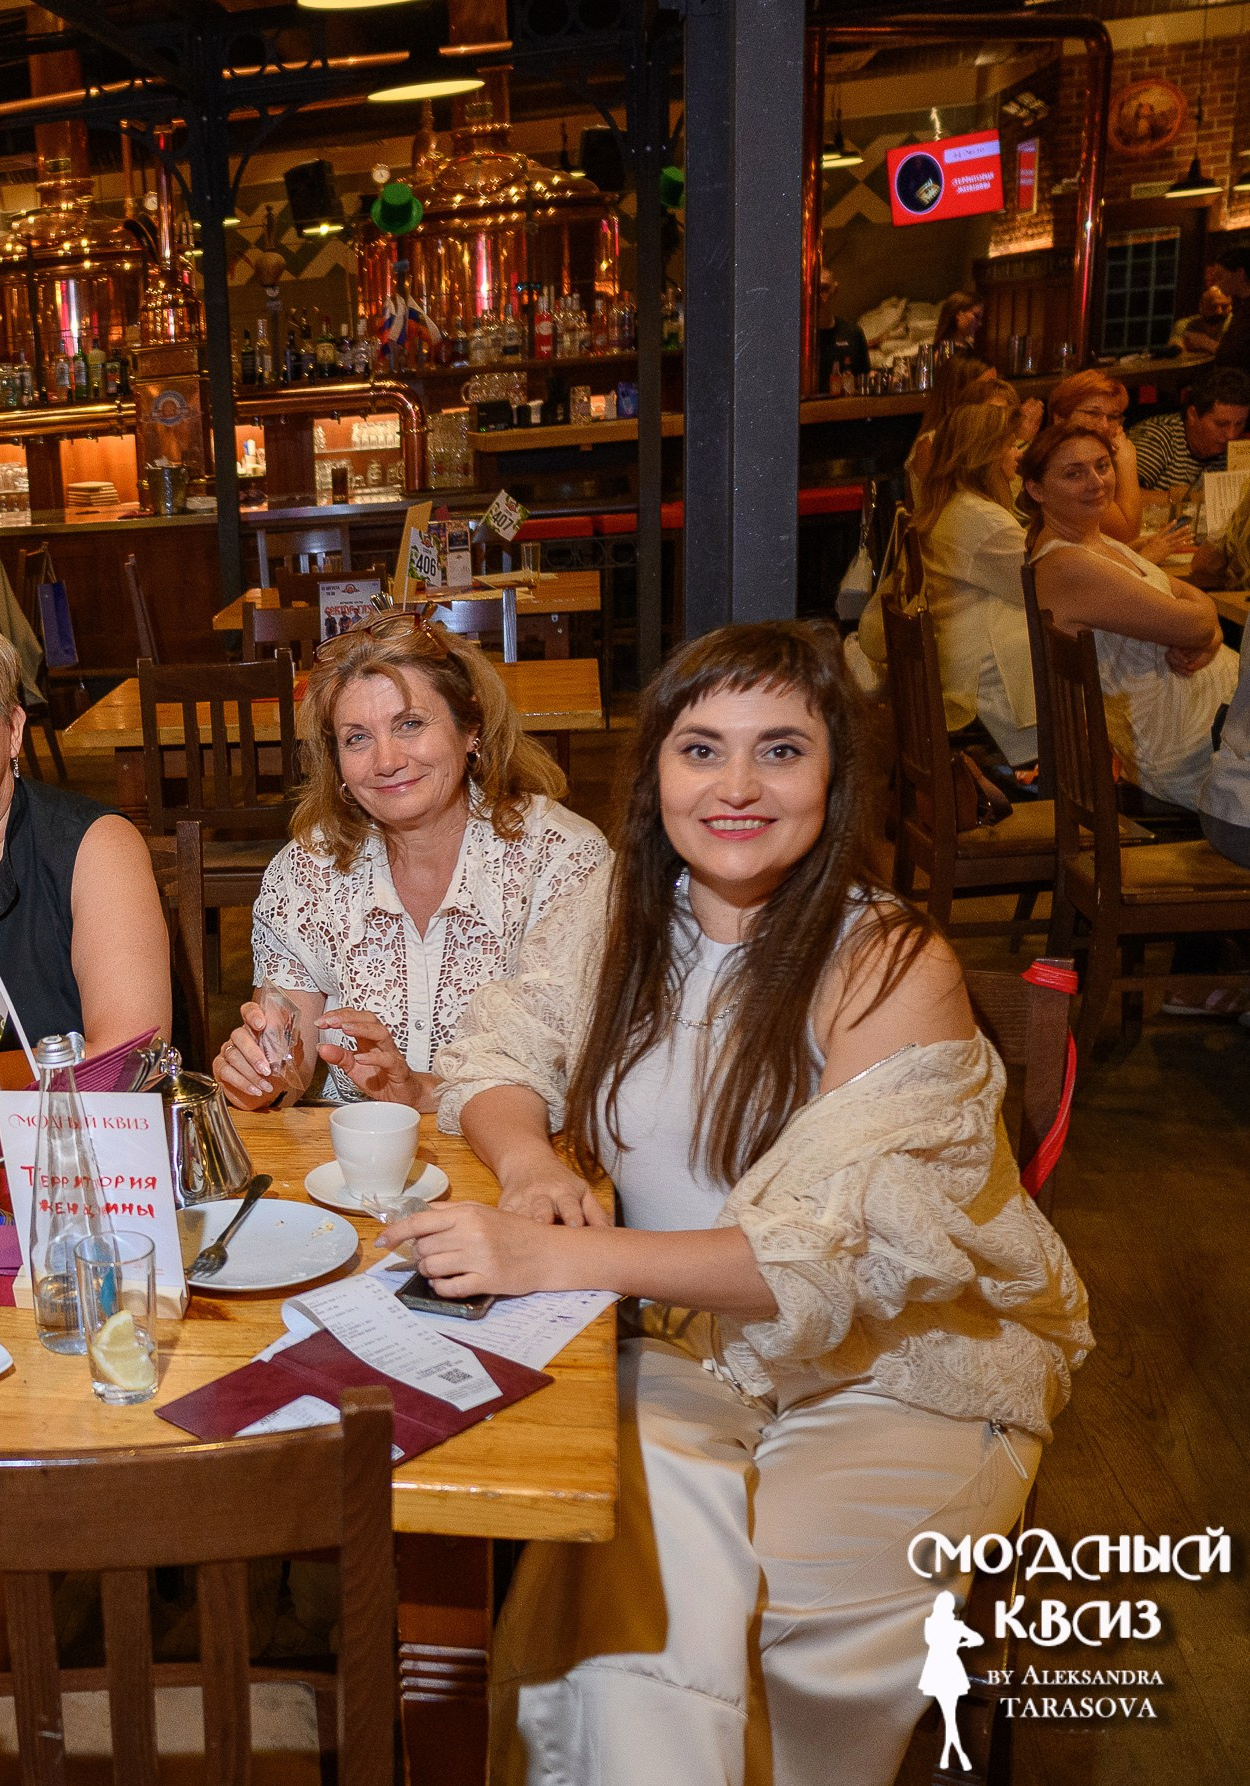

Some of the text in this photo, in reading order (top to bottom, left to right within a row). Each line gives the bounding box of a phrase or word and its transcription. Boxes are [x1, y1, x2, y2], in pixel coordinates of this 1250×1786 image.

[492, 511, 515, 531] 407
[416, 554, 437, 577] 406
[103, 1116, 150, 1131] КВИЗ
